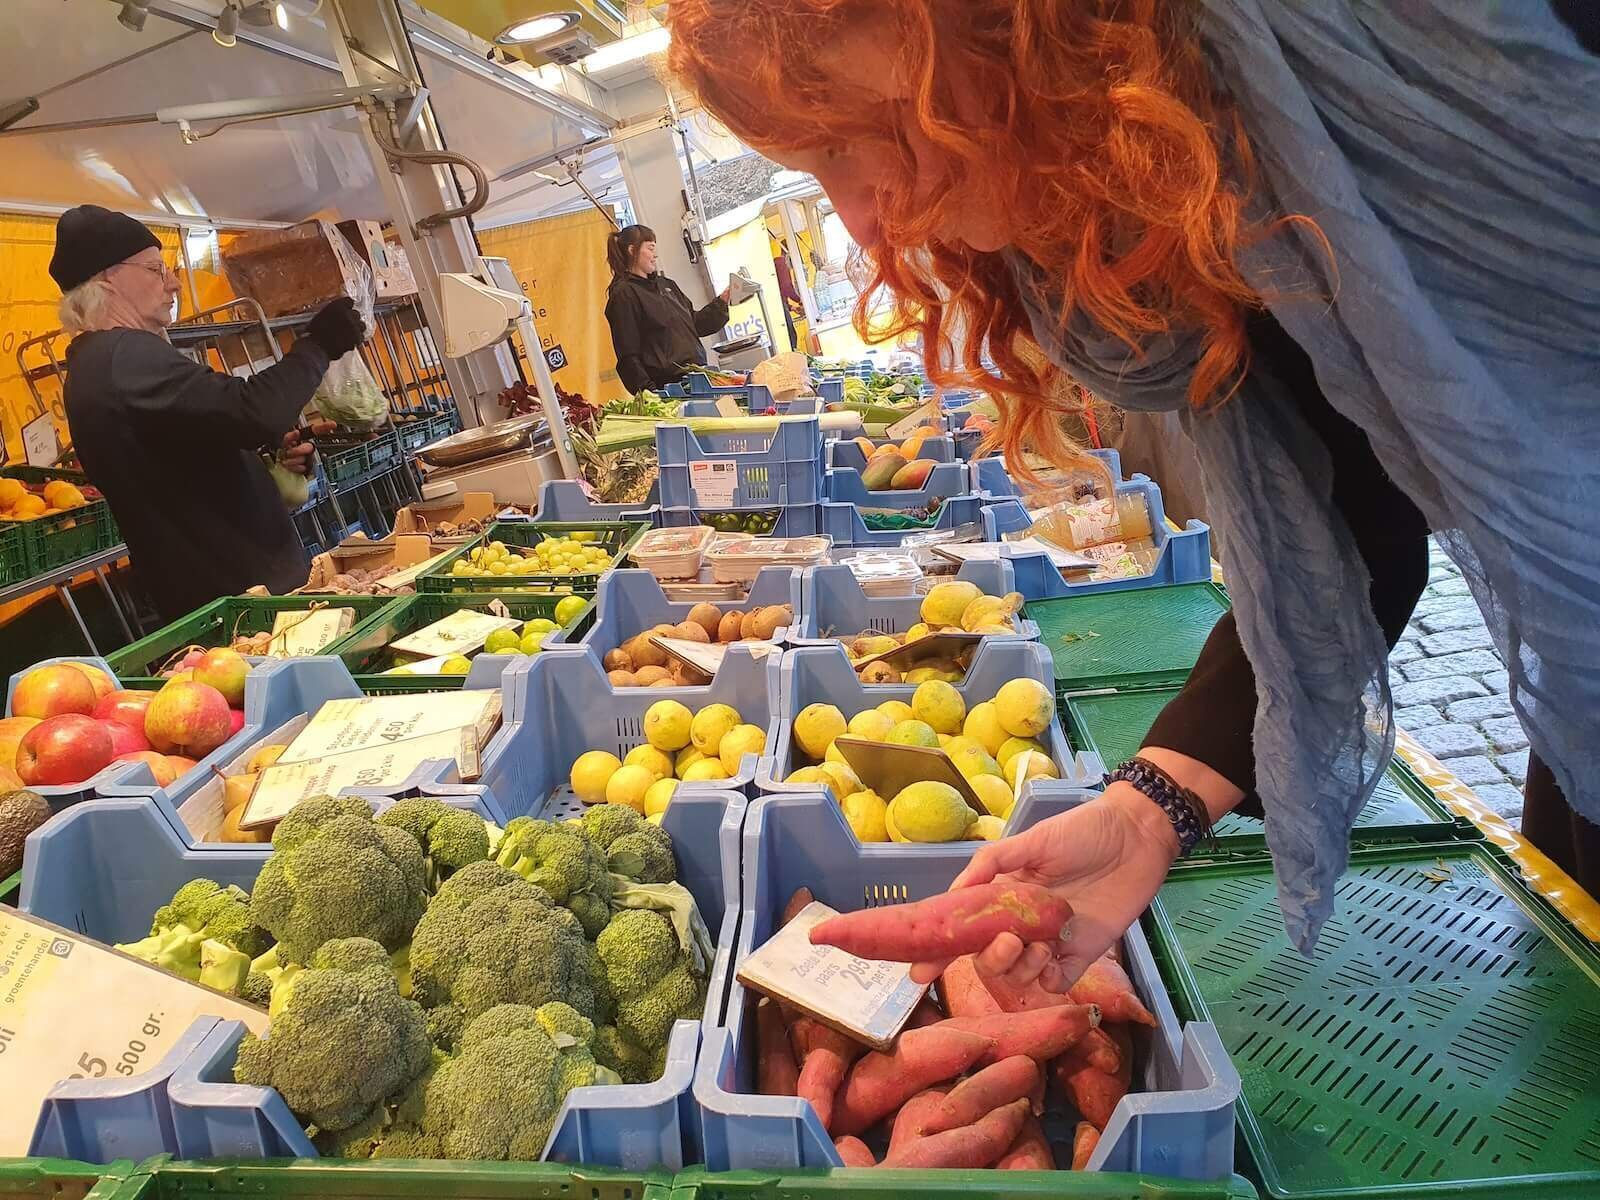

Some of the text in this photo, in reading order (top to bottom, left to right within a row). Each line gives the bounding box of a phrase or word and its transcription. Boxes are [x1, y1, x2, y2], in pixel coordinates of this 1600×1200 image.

[5, 938, 50, 1005] groentehandel
[815, 963, 841, 987] paars
[840, 957, 871, 990] 295
[872, 968, 886, 985] per
[115, 1010, 166, 1077] 500 gr.
[69, 1051, 108, 1081] 5
